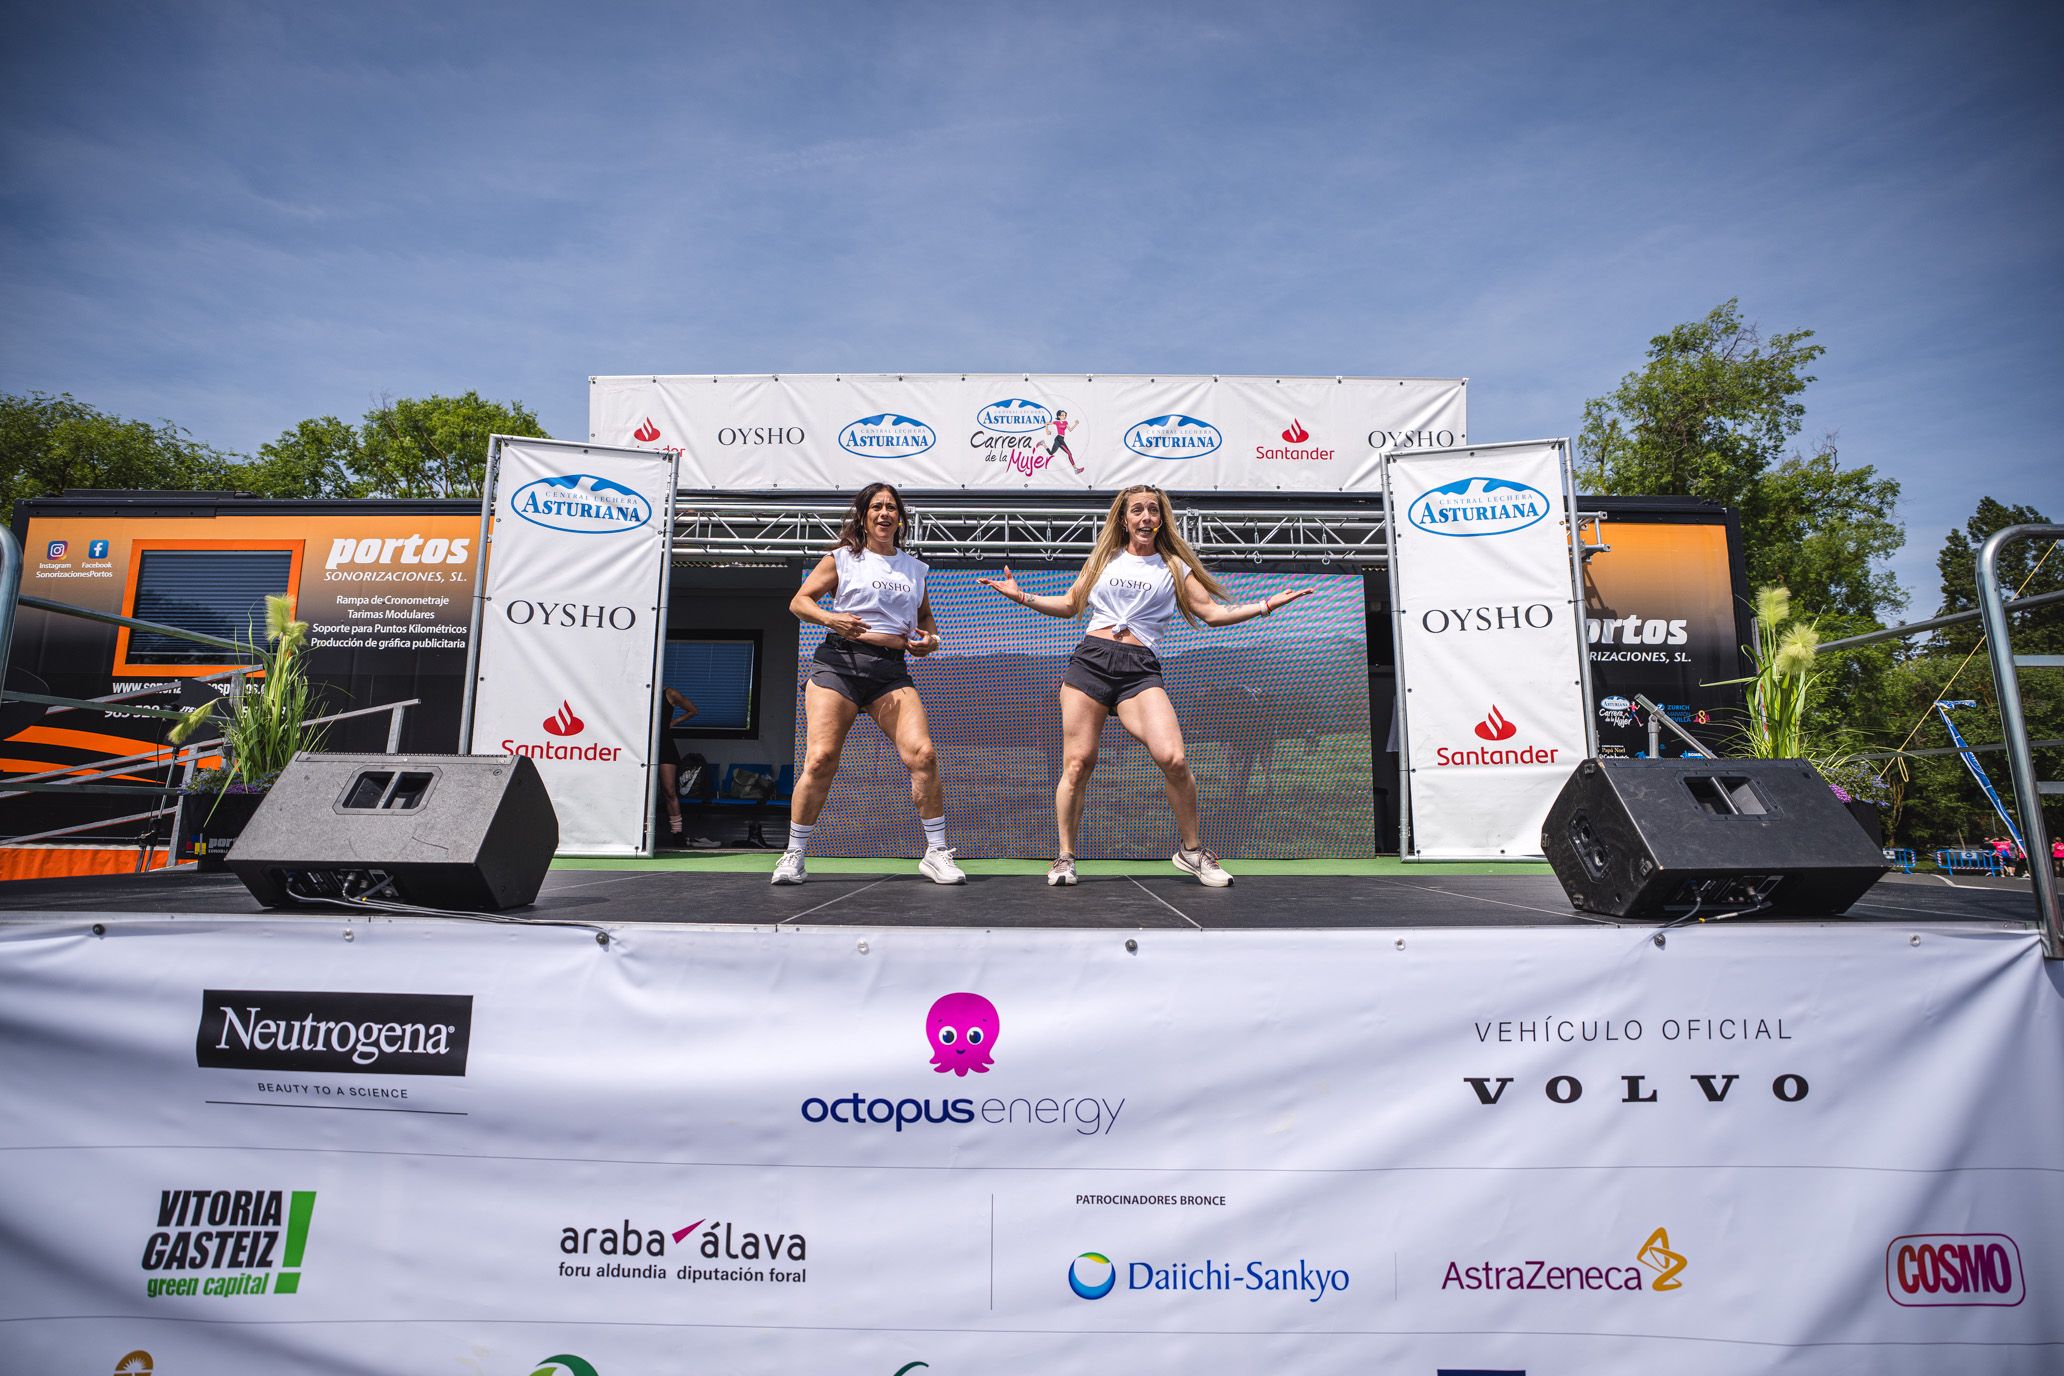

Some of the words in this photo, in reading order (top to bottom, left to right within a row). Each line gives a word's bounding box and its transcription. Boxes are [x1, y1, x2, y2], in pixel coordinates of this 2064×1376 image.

[983, 412, 1047, 425] ASTURIANA
[718, 427, 805, 446] OYSHO
[846, 430, 929, 448] ASTURIANA
[970, 431, 1032, 449] Carrera
[1132, 430, 1215, 449] ASTURIANA
[1368, 430, 1454, 449] OYSHO
[985, 453, 997, 462] de
[999, 449, 1008, 462] la
[1005, 448, 1055, 477] Mujer
[1256, 446, 1335, 460] Santander
[521, 491, 641, 522] ASTURIANA
[545, 491, 588, 500] CENTRAL
[594, 495, 638, 505] LECHERA
[1439, 496, 1482, 505] CENTRAL
[1487, 493, 1533, 502] LECHERA
[1418, 502, 1540, 524] ASTURIANA
[325, 534, 470, 570] portos
[35, 570, 113, 578] SonorizacionesPortos
[323, 571, 445, 583] SONORIZACIONES,
[449, 571, 467, 582] SL.
[872, 580, 911, 593] OYSHO
[1109, 577, 1152, 592] OYSHO
[336, 595, 368, 606] Rampa
[370, 595, 382, 605] de
[384, 595, 450, 606] Cronometraje
[347, 610, 383, 619] Tarimas
[385, 610, 435, 619] Modulares
[506, 599, 636, 630] OYSHO
[1422, 603, 1553, 634] OYSHO
[312, 624, 350, 635] Soporte
[351, 626, 373, 635] para
[374, 624, 407, 634] Puntos
[408, 624, 467, 634] Kilométricos
[1586, 614, 1688, 645] ortos
[310, 638, 363, 648] Producción
[365, 638, 377, 648] de
[378, 638, 411, 650] gráfica
[412, 638, 466, 650] publicitaria
[1590, 651, 1669, 664] RIZACIONES,
[1674, 652, 1692, 662] SL.
[502, 739, 622, 762] Santander
[1437, 746, 1558, 766] Santander
[1475, 1015, 1643, 1042] VEHÍCULO
[1662, 1018, 1792, 1040] OFICIAL
[257, 1082, 309, 1094] BEAUTY
[313, 1085, 332, 1095] TO
[336, 1086, 345, 1096] A
[349, 1087, 409, 1099] SCIENCE
[1464, 1073, 1809, 1105] VOLVO
[801, 1092, 975, 1132] octopus
[981, 1097, 1126, 1136] energy
[157, 1190, 283, 1227] VITORIA
[1076, 1194, 1177, 1205] PATROCINADORES
[1180, 1196, 1226, 1206] BRONCE
[560, 1219, 665, 1257] araba
[700, 1221, 806, 1261] álava
[141, 1231, 280, 1270] GASTEIZ
[559, 1262, 591, 1277] foru
[596, 1263, 667, 1279] aldundia
[676, 1266, 764, 1283] diputación
[769, 1268, 806, 1283] foral
[1441, 1261, 1642, 1291] AstraZeneca
[1897, 1243, 2012, 1294] COSMO
[147, 1277, 199, 1298] green
[203, 1272, 270, 1298] capital
[1128, 1259, 1350, 1303] Daiichi-Sankyo
